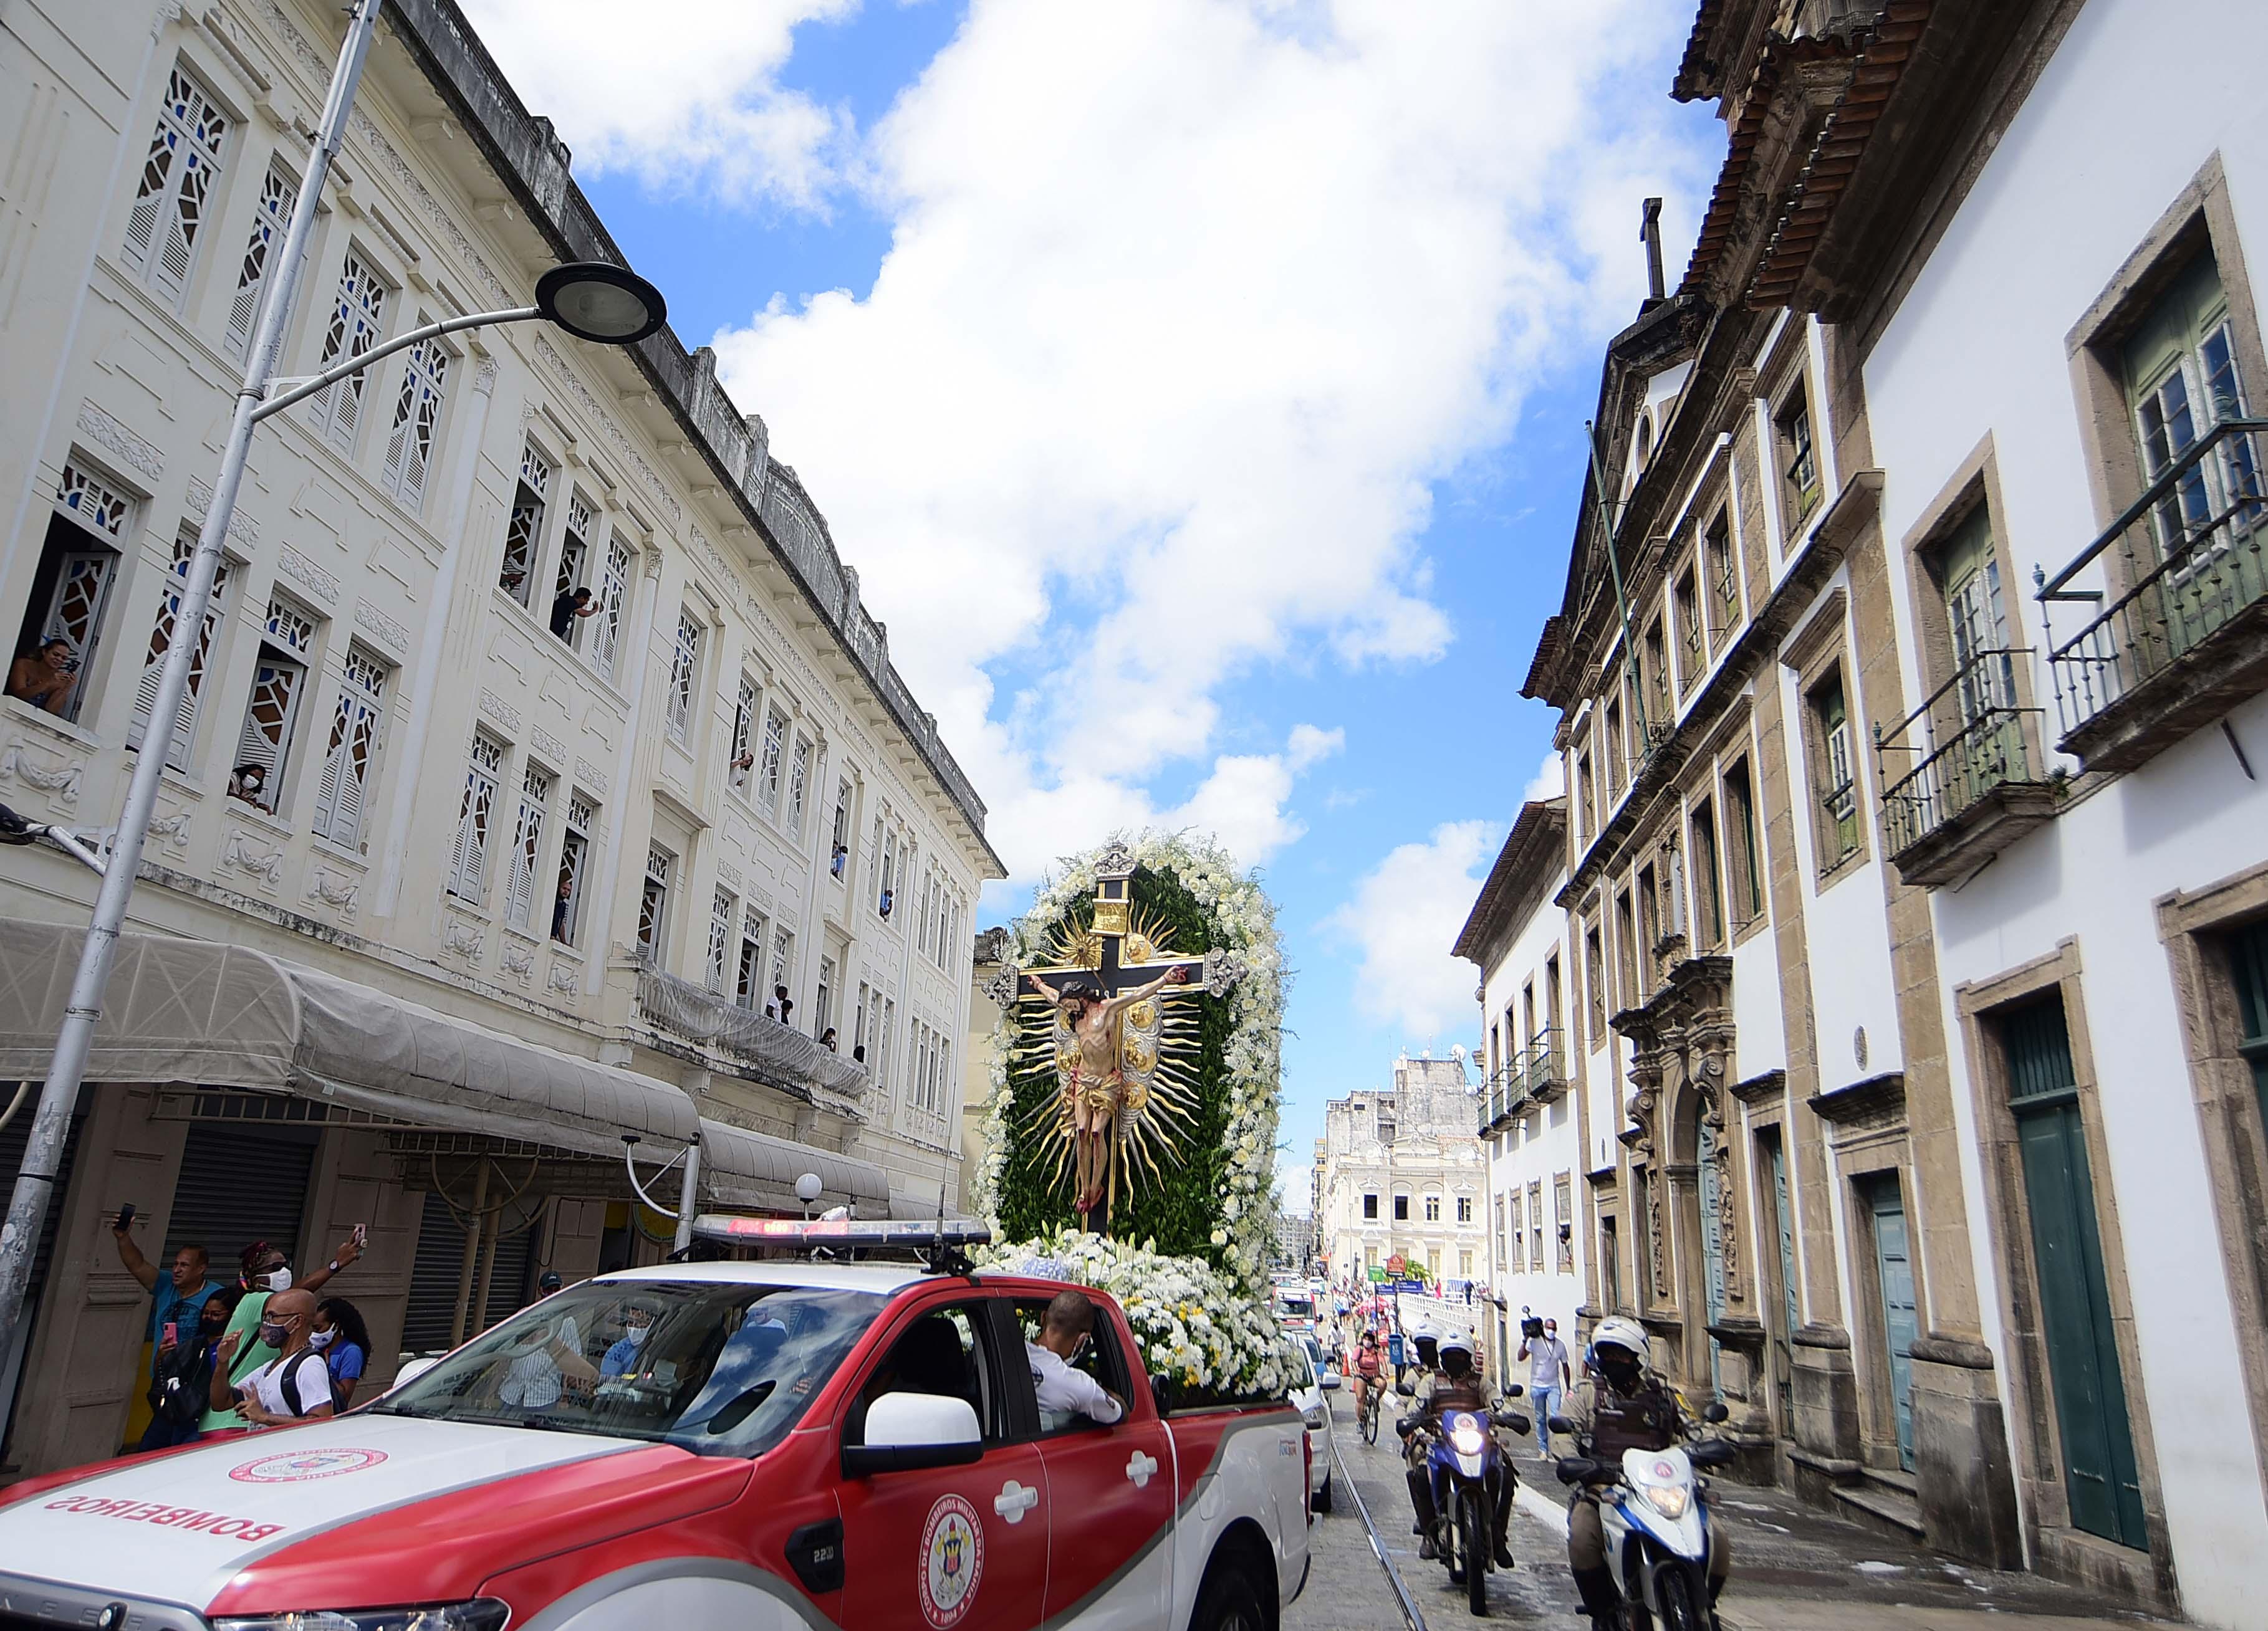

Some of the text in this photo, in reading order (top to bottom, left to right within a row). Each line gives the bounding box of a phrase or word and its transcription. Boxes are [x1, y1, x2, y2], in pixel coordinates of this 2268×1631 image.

[921, 1498, 982, 1612] CORPO DE BOMBEIROS MILITAR DA BAHIA
[941, 1608, 958, 1624] 1894
